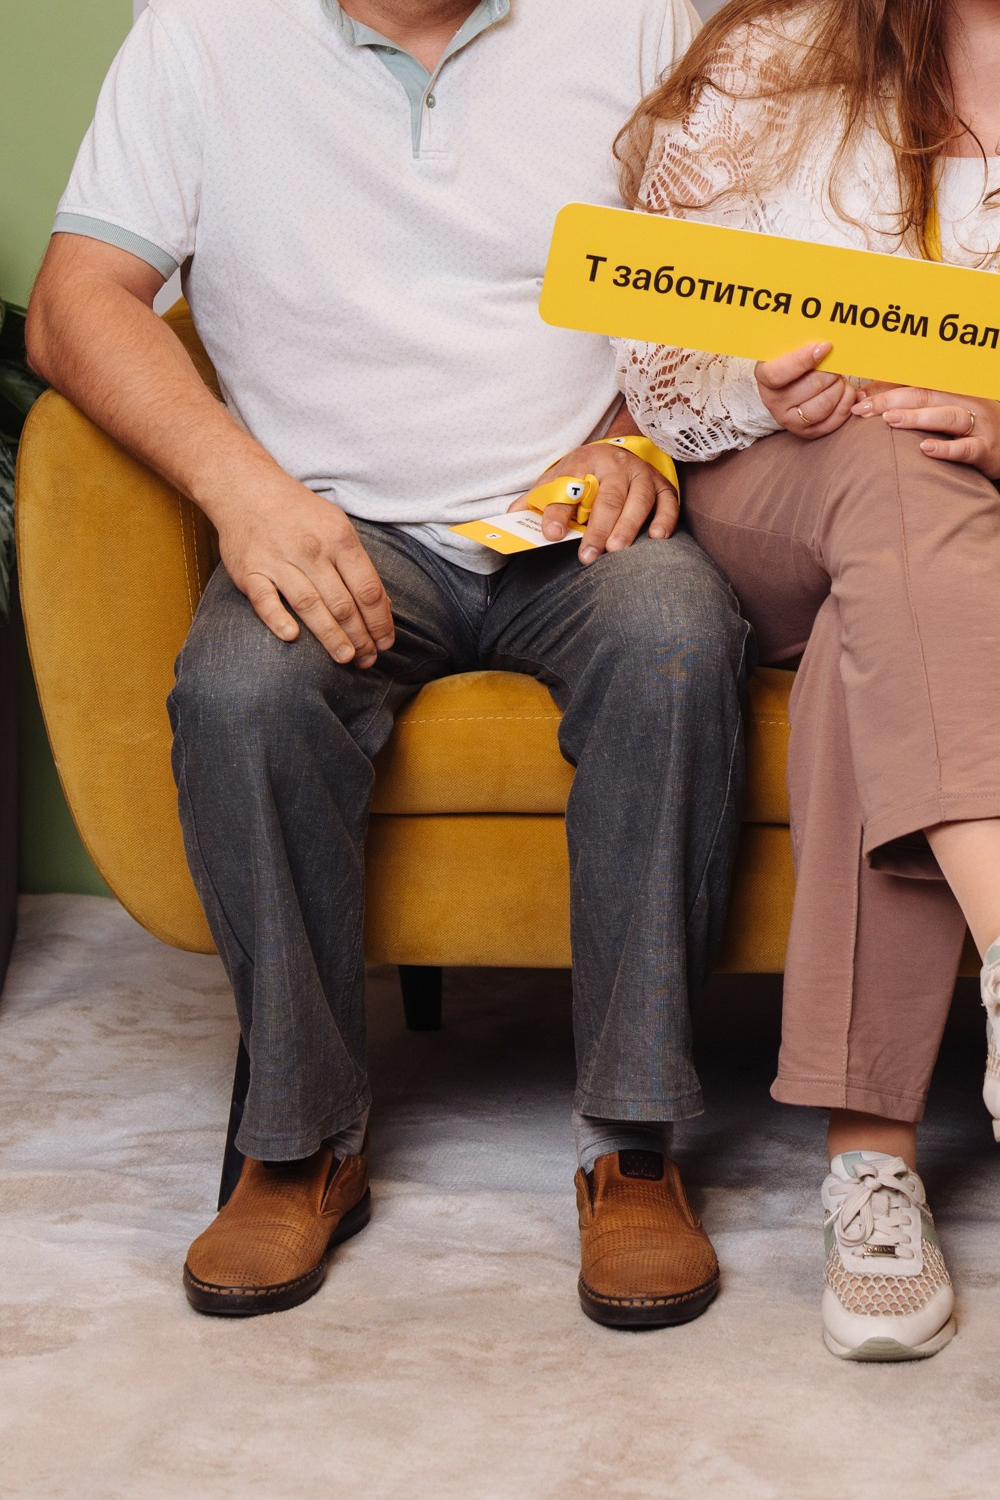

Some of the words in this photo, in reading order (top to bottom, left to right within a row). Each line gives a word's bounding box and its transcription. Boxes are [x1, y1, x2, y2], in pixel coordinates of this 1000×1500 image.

[585, 254, 608, 282] Т
[612, 265, 793, 315] заботится
[801, 297, 822, 319] о
[829, 301, 929, 338] моём
